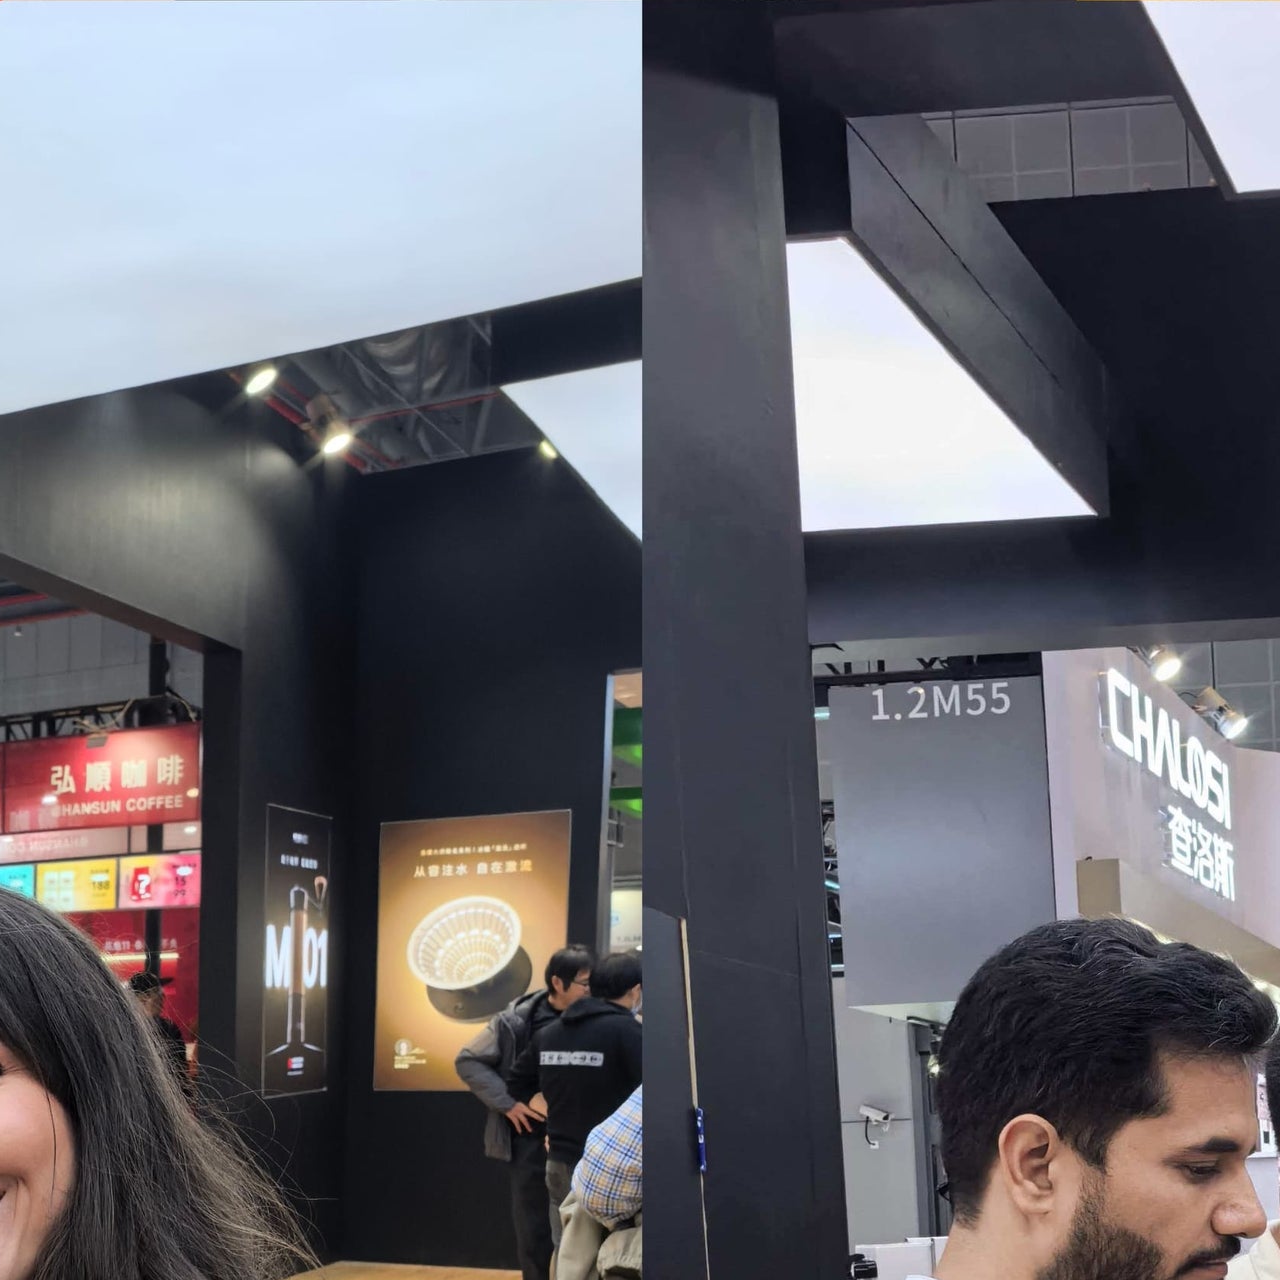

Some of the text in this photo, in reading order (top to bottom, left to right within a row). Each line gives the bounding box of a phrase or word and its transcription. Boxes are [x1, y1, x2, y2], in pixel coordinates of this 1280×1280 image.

[871, 682, 1011, 721] 1.2M55
[1105, 666, 1233, 830] CHALOSI
[126, 795, 183, 812] COFFEE
[1166, 804, 1236, 902] 查洛斯
[265, 924, 291, 988] M
